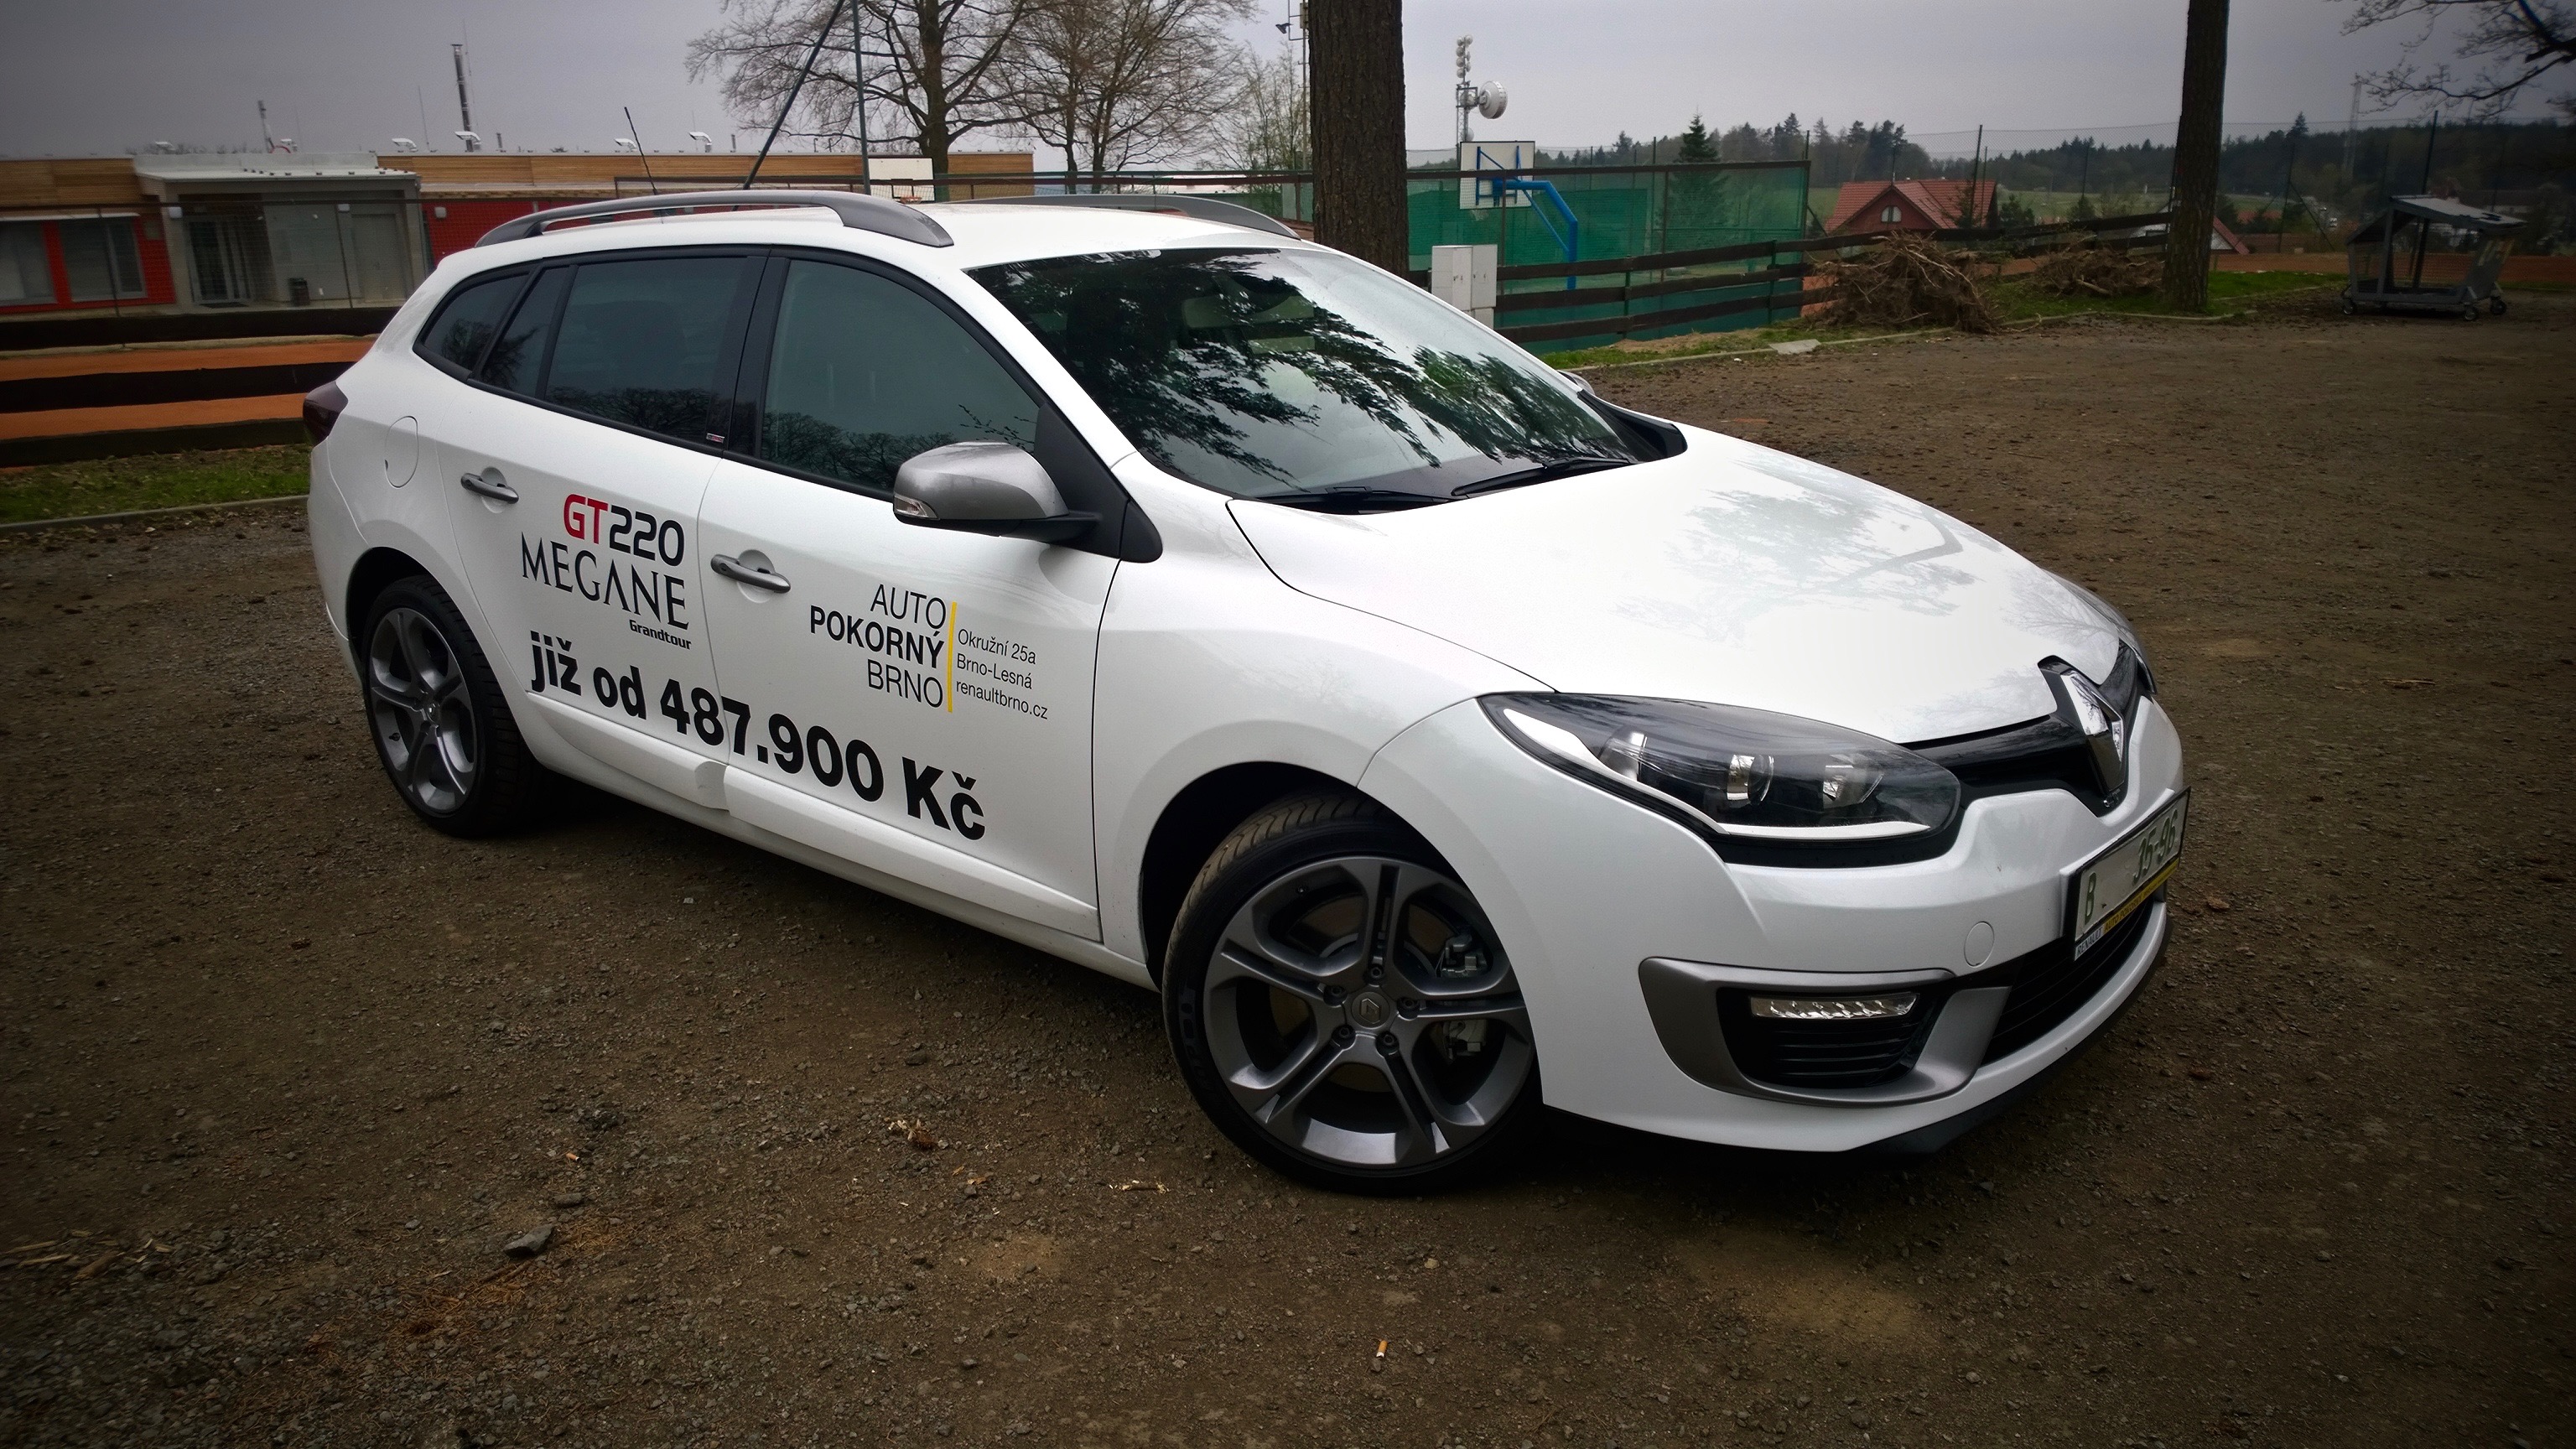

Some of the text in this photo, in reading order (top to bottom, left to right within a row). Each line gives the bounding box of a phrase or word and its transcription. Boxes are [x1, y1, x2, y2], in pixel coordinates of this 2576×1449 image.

[564, 494, 685, 567] GT220
[870, 584, 947, 630] AUTO
[629, 619, 692, 650] Grandtour
[810, 605, 945, 669] POKORNÝ
[958, 628, 1036, 665] Okružní 25a
[867, 658, 943, 709] BRNO
[957, 652, 1032, 689] Brno-Lesná
[956, 680, 1048, 719] renaultbrno.cz
[530, 630, 985, 840] již od 487.900 Kč
